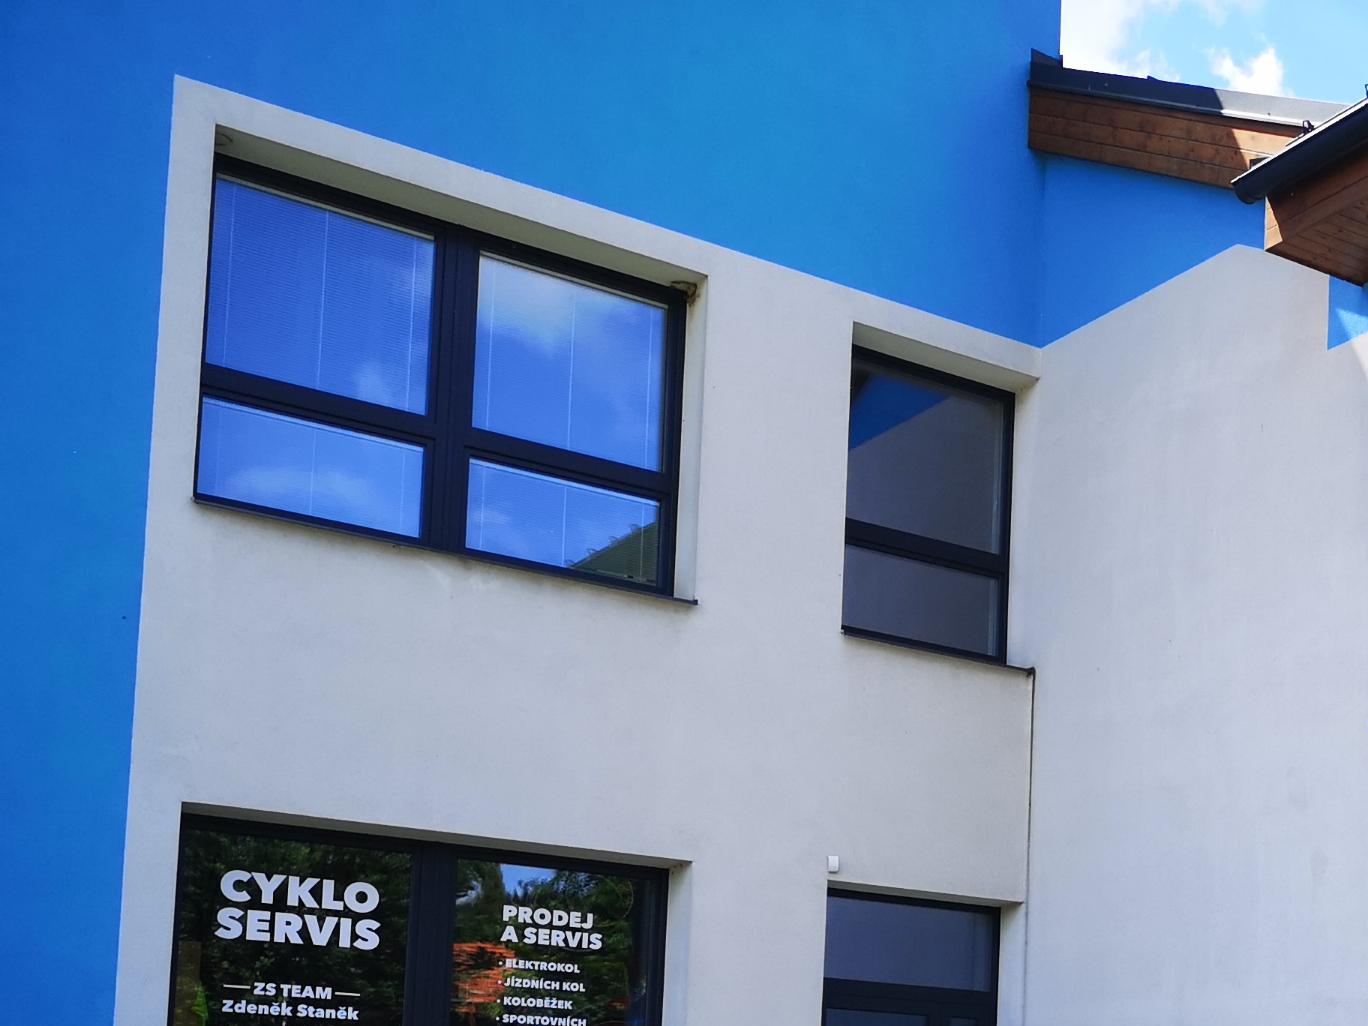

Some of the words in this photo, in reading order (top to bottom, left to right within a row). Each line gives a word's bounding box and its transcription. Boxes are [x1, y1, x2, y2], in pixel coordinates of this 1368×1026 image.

[220, 869, 380, 914] CYKLO
[502, 904, 594, 930] PRODEJ
[214, 907, 381, 951] SERVIS
[500, 925, 519, 943] A
[522, 926, 603, 951] SERVIS
[505, 958, 581, 974] ELEKTROKOL
[253, 982, 277, 996] ZS
[280, 984, 332, 1000] TEAM
[503, 975, 560, 991] JÍZDNÍCH
[562, 981, 586, 993] KOL
[221, 1000, 293, 1017] Zdeněk
[296, 1004, 359, 1021] Staněk
[503, 996, 573, 1010] KOLOBĚŽEK
